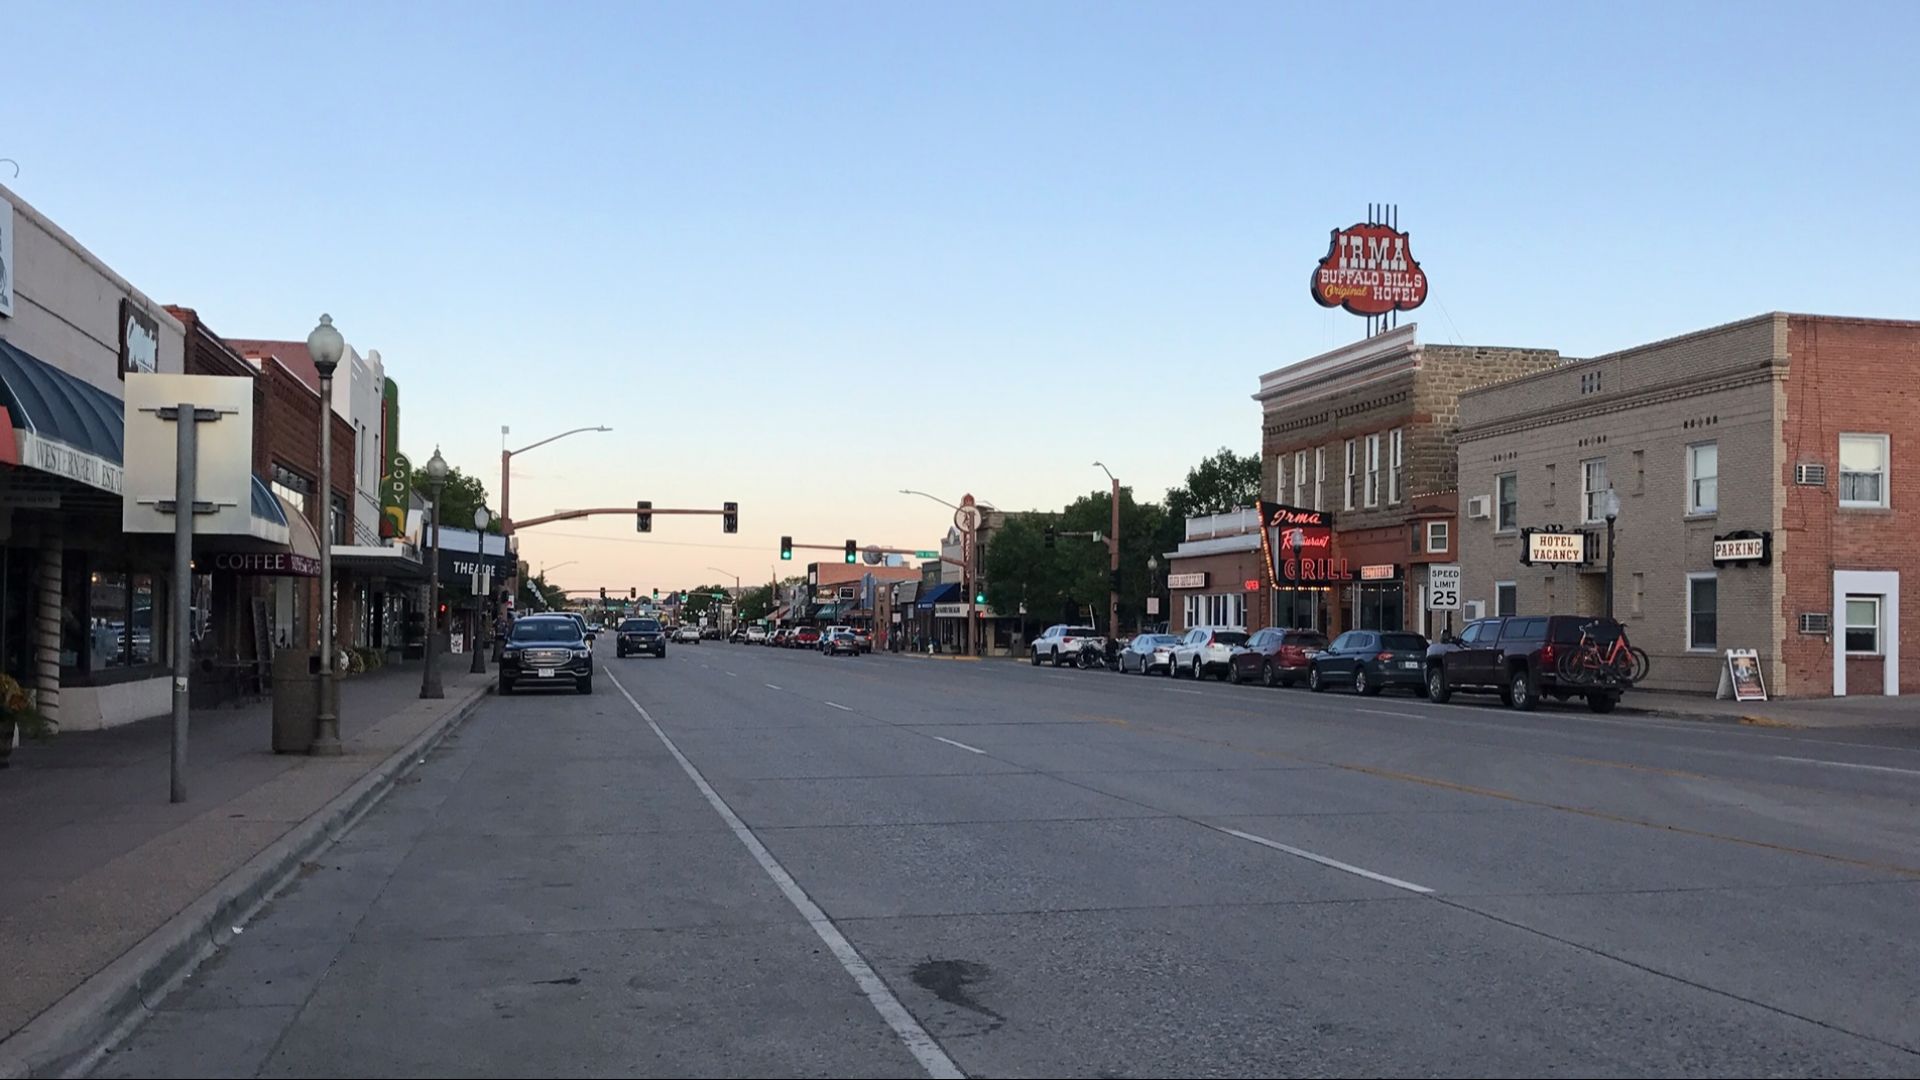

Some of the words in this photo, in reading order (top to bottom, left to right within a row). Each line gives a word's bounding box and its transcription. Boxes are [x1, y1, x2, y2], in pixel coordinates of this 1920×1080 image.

[1339, 234, 1407, 271] IRMA
[1320, 269, 1379, 286] BUFFALO
[1383, 272, 1422, 287] BILLS
[1325, 283, 1367, 298] Original
[1373, 286, 1419, 301] HOTEL
[36, 439, 79, 476] WESTERN
[102, 464, 123, 492] ESTAT
[393, 457, 405, 504] CODY
[1270, 509, 1322, 526] Irma
[1281, 528, 1329, 550] Retaurant
[1540, 536, 1573, 547] HOTEL
[1533, 549, 1579, 560] VACANCY
[1715, 541, 1760, 557] PARKING
[216, 553, 285, 570] COFFEE
[1284, 558, 1353, 580] GRILL
[1432, 570, 1459, 578] SPEED
[1434, 580, 1456, 588] LIMIT
[1433, 591, 1457, 605] 25
